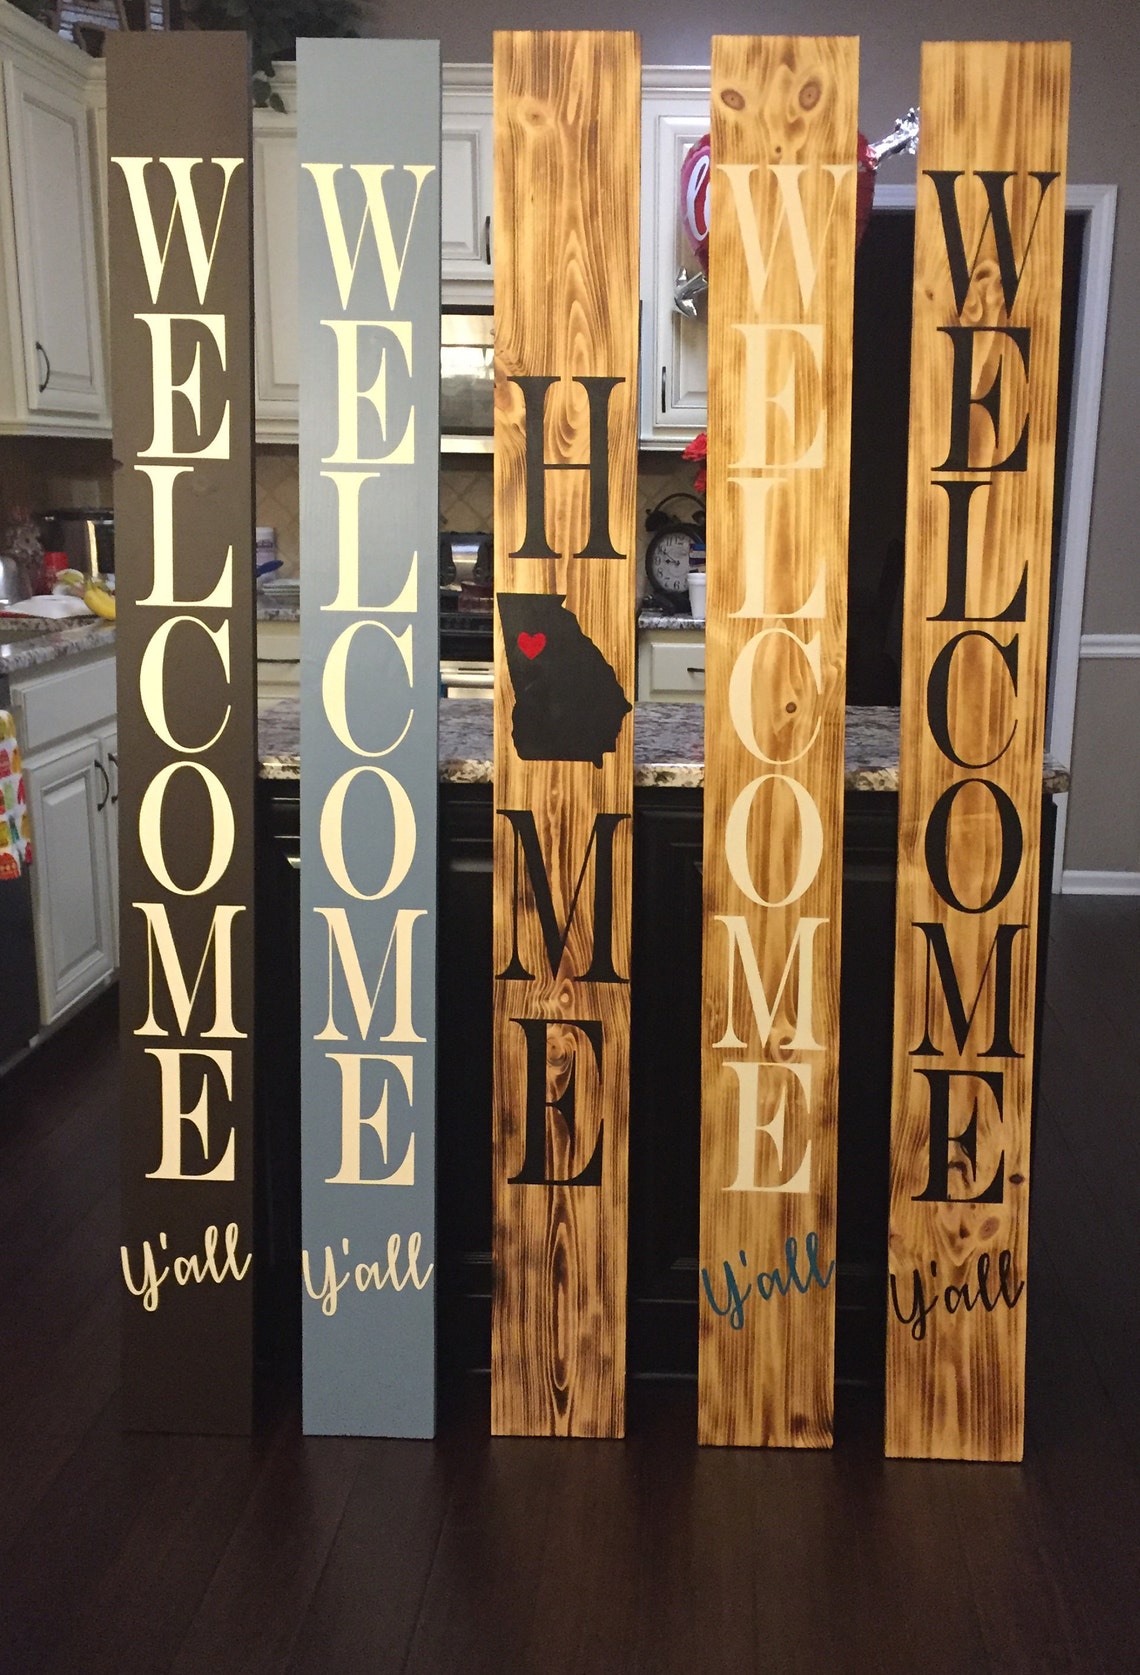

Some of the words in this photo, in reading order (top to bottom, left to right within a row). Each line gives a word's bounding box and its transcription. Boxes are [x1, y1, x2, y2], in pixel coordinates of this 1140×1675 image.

[111, 157, 247, 1181] WELCOME
[301, 163, 436, 1185] WELCOME
[712, 164, 854, 1192] WELCOME
[909, 170, 1060, 1203] WELCOME
[120, 1222, 252, 1311] Y'all
[302, 1232, 434, 1316] Y'all
[701, 1231, 835, 1330] Y'all
[890, 1250, 1025, 1341] Y'all
